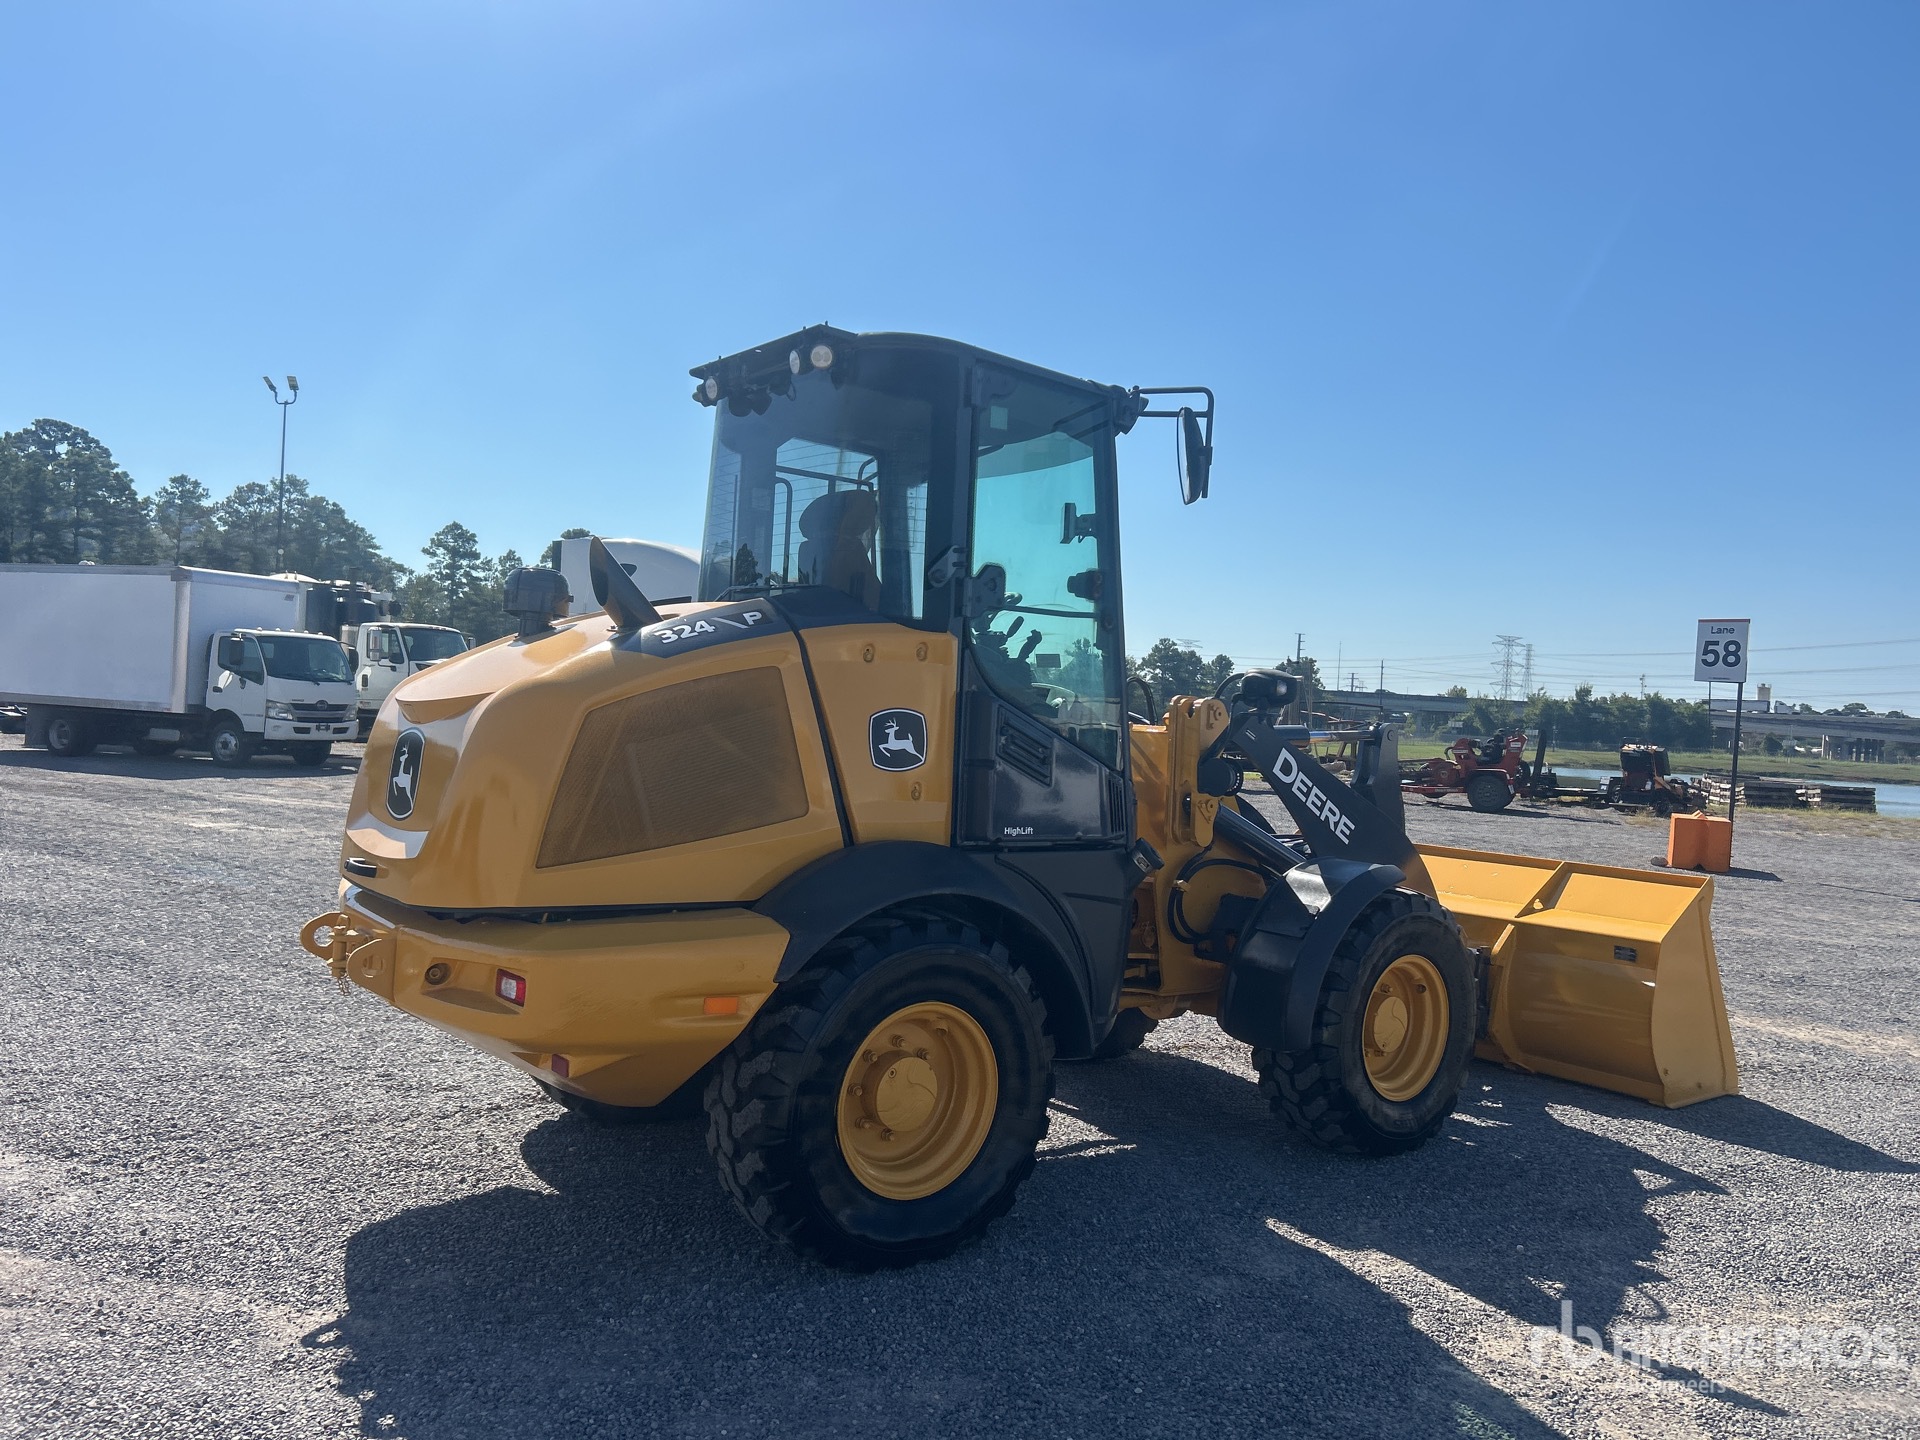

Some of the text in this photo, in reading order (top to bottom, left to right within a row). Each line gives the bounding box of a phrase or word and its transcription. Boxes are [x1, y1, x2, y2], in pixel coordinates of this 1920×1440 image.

[654, 611, 762, 644] 324 P
[1710, 626, 1735, 634] Lane
[1701, 640, 1741, 667] 58
[1272, 747, 1356, 845] DEERE
[1004, 827, 1034, 836] HighLift
